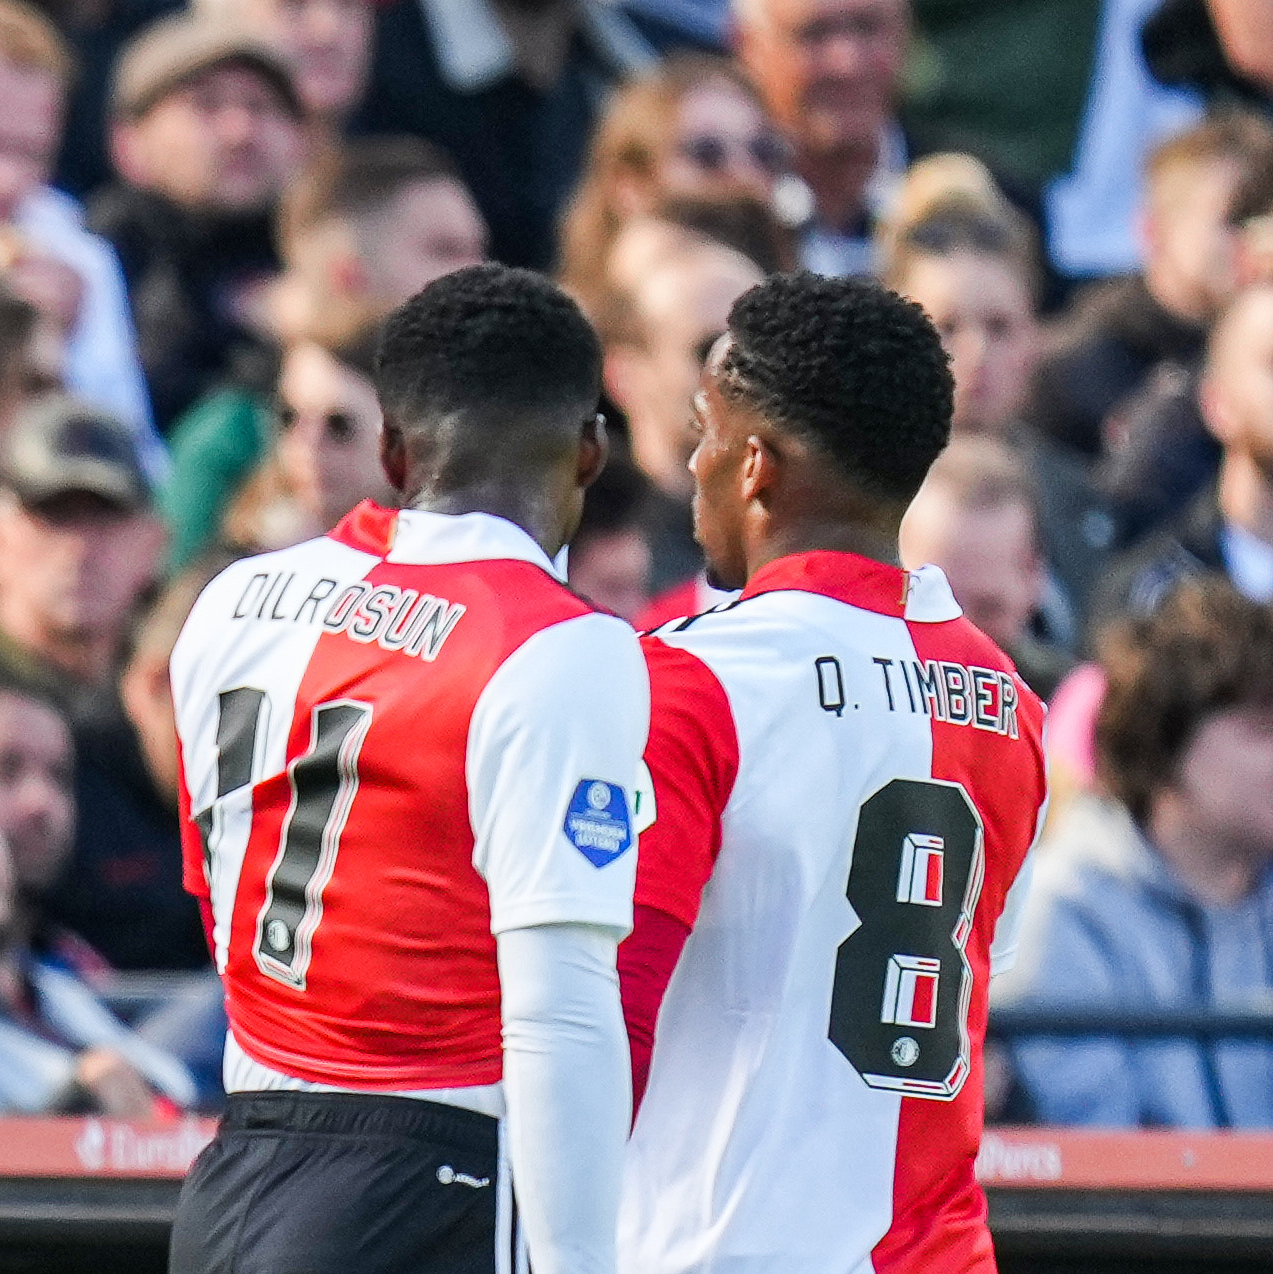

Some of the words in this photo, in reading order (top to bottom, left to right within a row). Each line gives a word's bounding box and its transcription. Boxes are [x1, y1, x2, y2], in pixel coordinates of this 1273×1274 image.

[232, 573, 467, 662] DILROSUN
[815, 656, 860, 717] Q.
[872, 656, 1020, 740] TIMBER
[190, 686, 373, 991] 11
[827, 778, 986, 1102] 8
